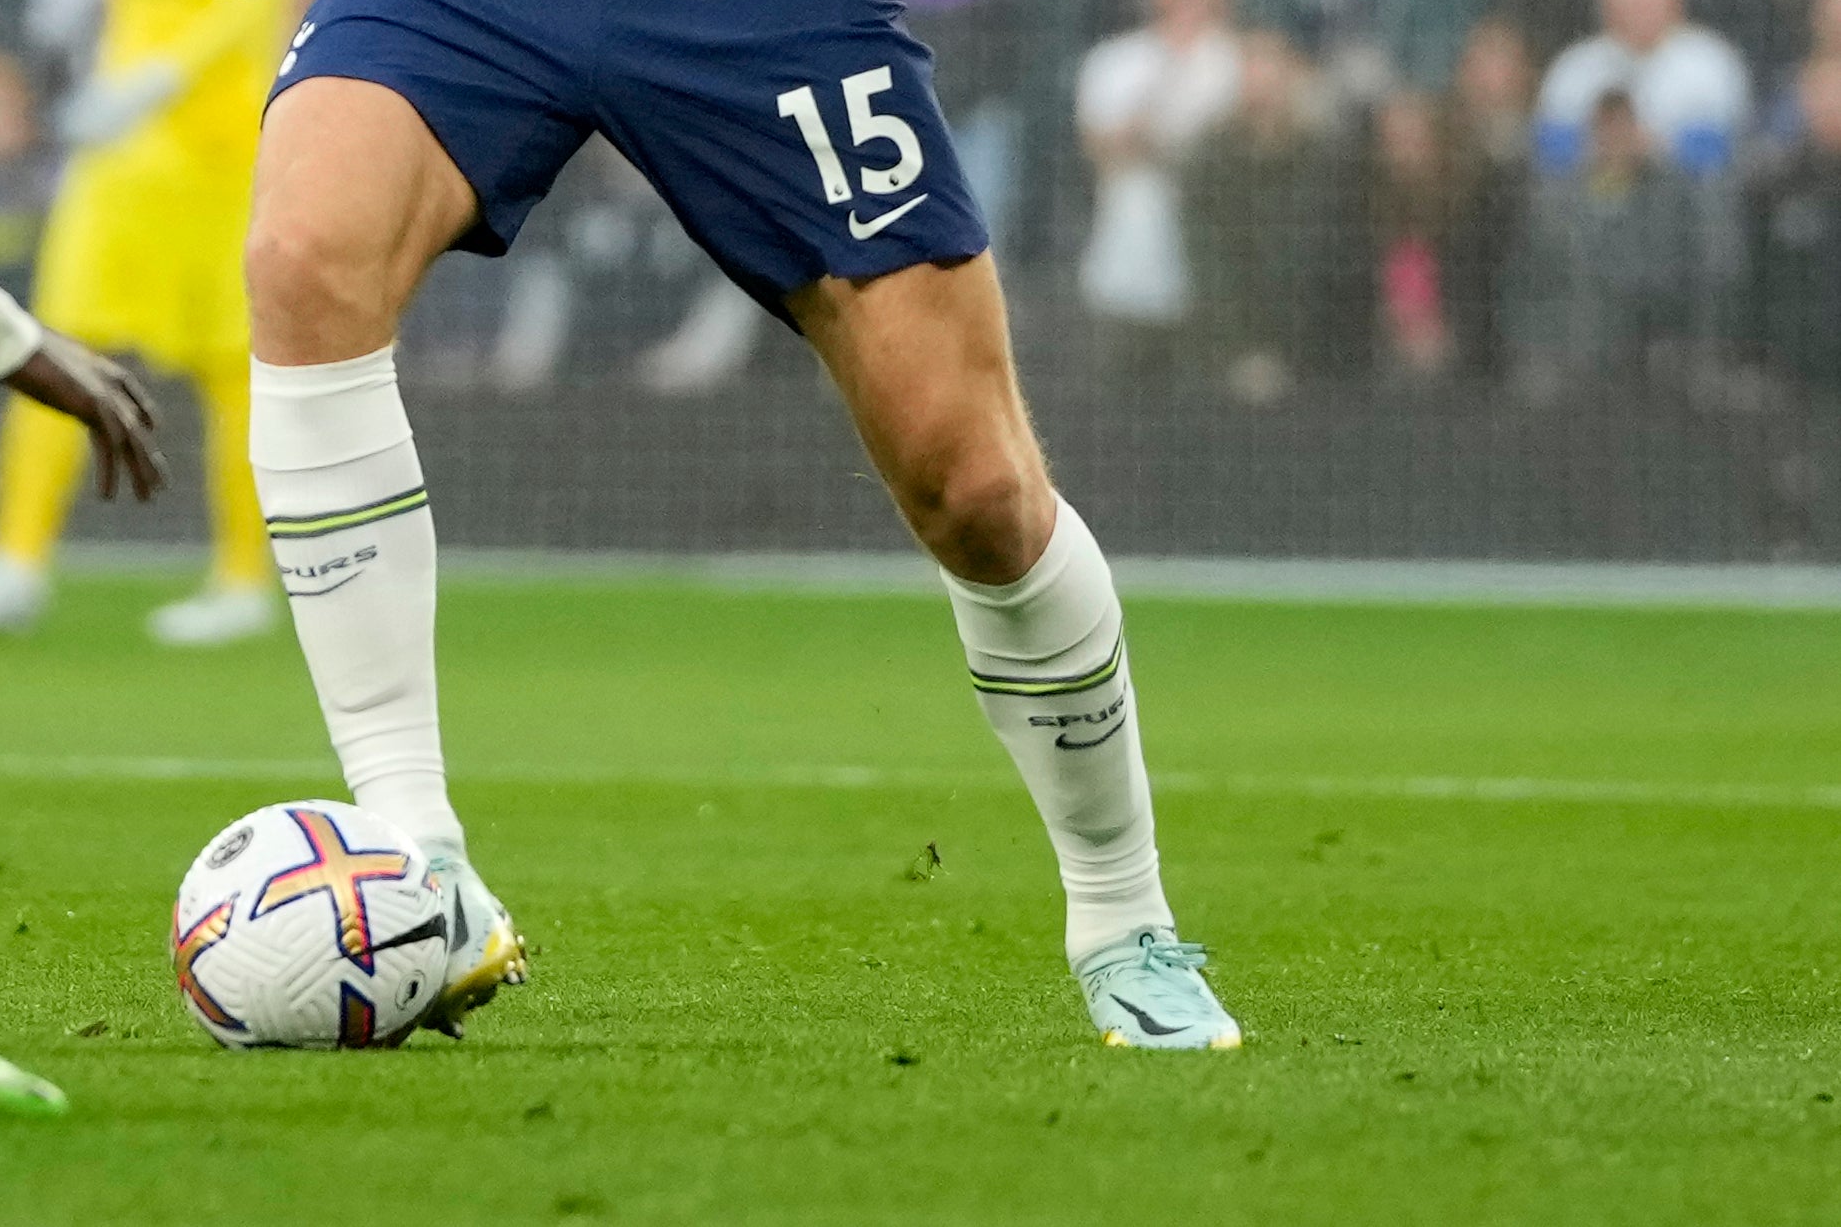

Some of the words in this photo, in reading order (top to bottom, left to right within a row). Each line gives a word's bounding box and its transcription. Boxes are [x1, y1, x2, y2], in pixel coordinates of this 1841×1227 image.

[776, 65, 924, 204] 15
[278, 544, 378, 578] PURS
[1027, 685, 1127, 727] SPUR
